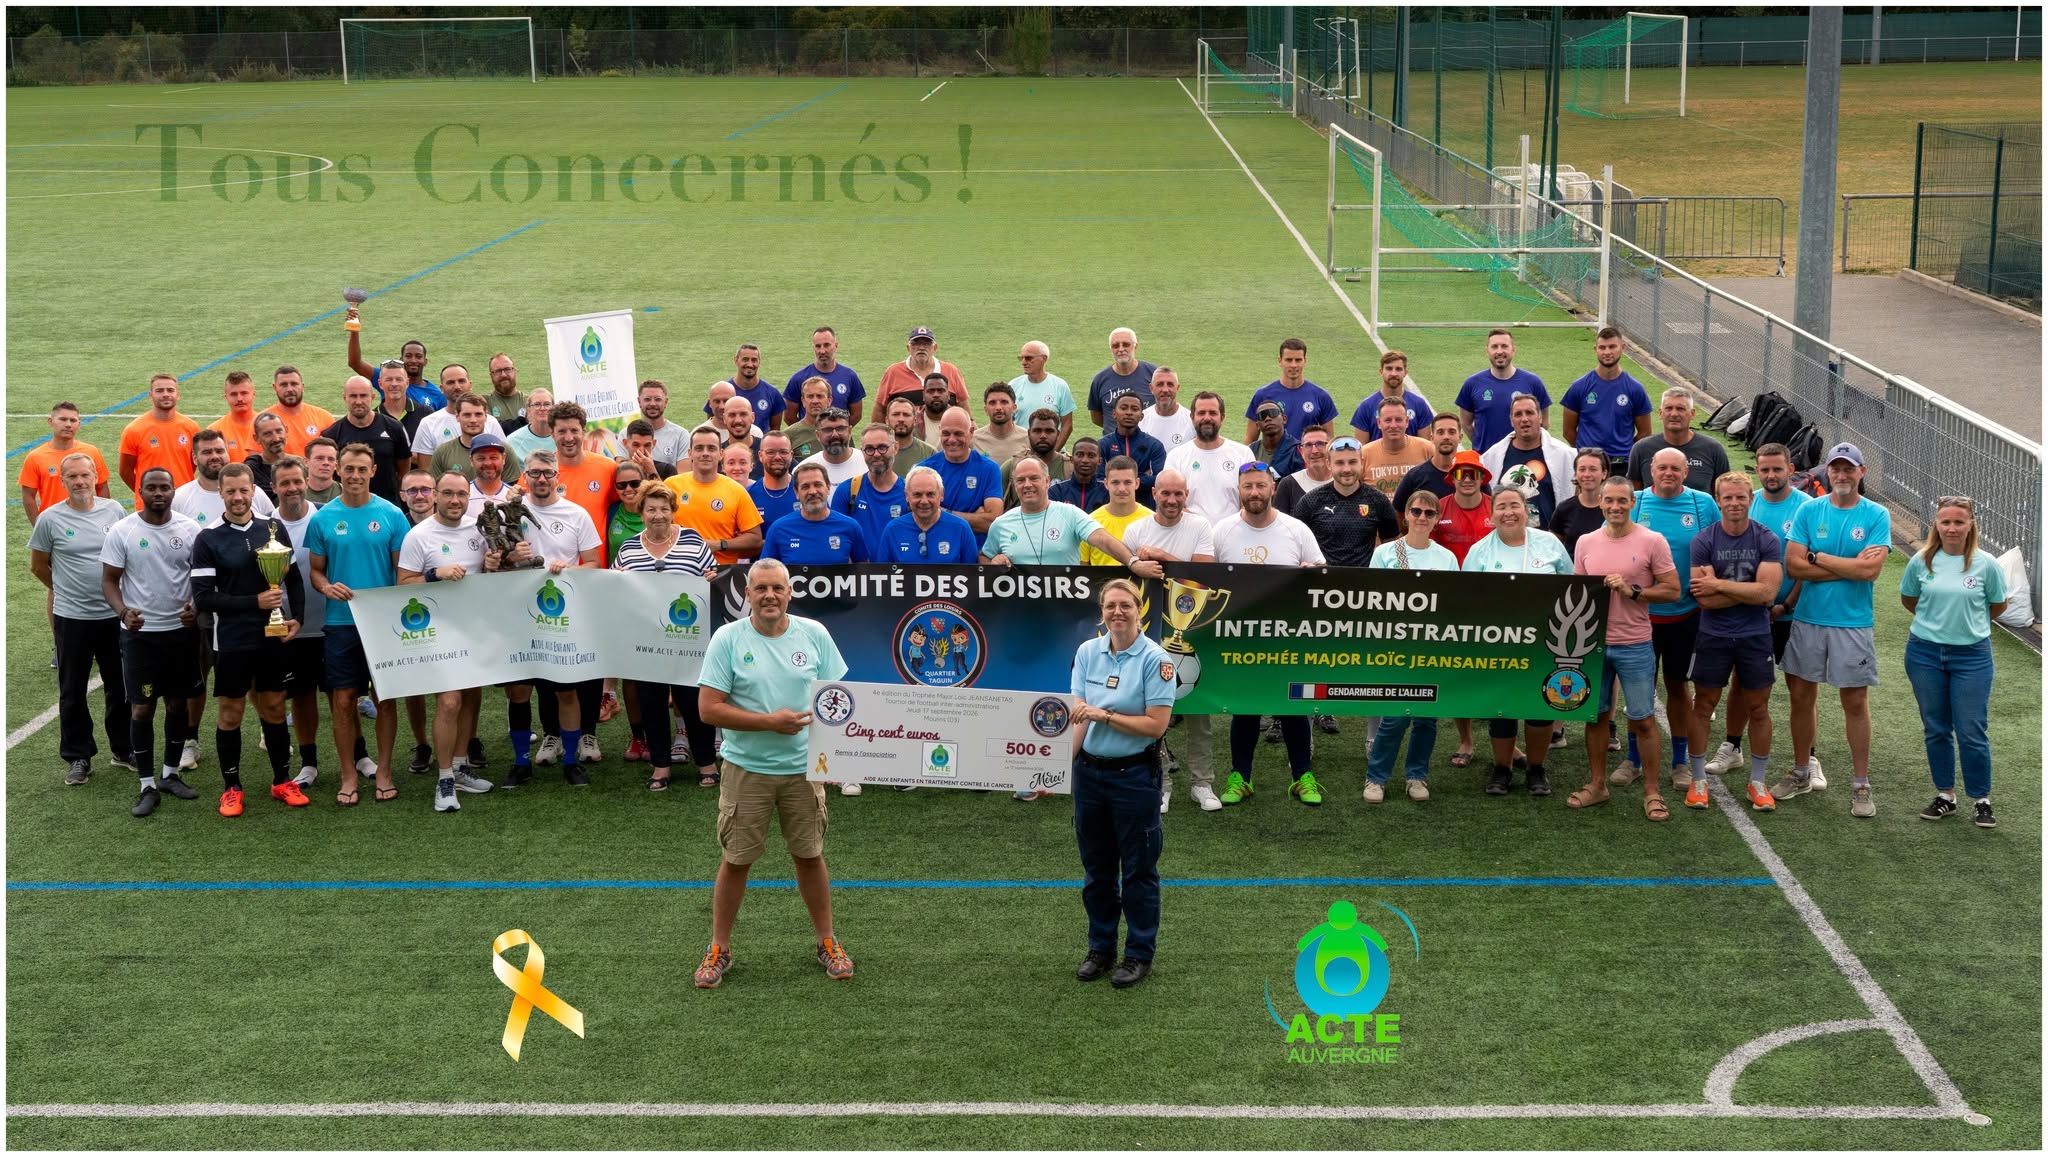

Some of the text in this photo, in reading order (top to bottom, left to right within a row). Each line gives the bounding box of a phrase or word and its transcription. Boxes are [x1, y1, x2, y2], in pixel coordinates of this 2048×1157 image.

[580, 361, 607, 374] ACTE
[594, 405, 611, 418] CONTRE
[1370, 465, 1399, 480] TOKYO
[1243, 547, 1254, 556] 10
[1716, 549, 1758, 561] NORWAY
[790, 568, 1091, 600] COMITÉ DES LOISIRS
[1307, 588, 1438, 613] TOURNOI
[943, 604, 962, 615] LOISIRS
[536, 614, 570, 626] ACTE
[401, 627, 437, 641] ACTE
[537, 624, 569, 633] AUVERGNE
[665, 624, 701, 634] ACTE
[1215, 619, 1538, 645] INTER-ADMINISTRATIONS
[402, 638, 437, 647] AUVERGNE
[665, 633, 699, 641] AUVERGNE
[531, 639, 544, 649] AIDE
[553, 641, 577, 653] ENFANTS
[510, 654, 518, 664] EN
[569, 655, 575, 665] LE
[576, 653, 596, 664] CANCER
[1221, 650, 1530, 670] TROPHÉE MAJOR LOÏC JEANSANETAS
[925, 670, 956, 678] QUARTIER
[1328, 687, 1384, 697] GENDARMERIE
[1385, 688, 1397, 697] DE
[916, 699, 940, 707] football
[968, 695, 1014, 703] JEANSANETAS
[930, 708, 962, 717] septembre
[845, 721, 941, 743] Cinq cent euros
[834, 749, 853, 757] Remis
[853, 749, 859, 757] à
[1005, 742, 1052, 757] 500 €
[928, 765, 951, 773] ACTE
[1029, 770, 1066, 789] Merci!
